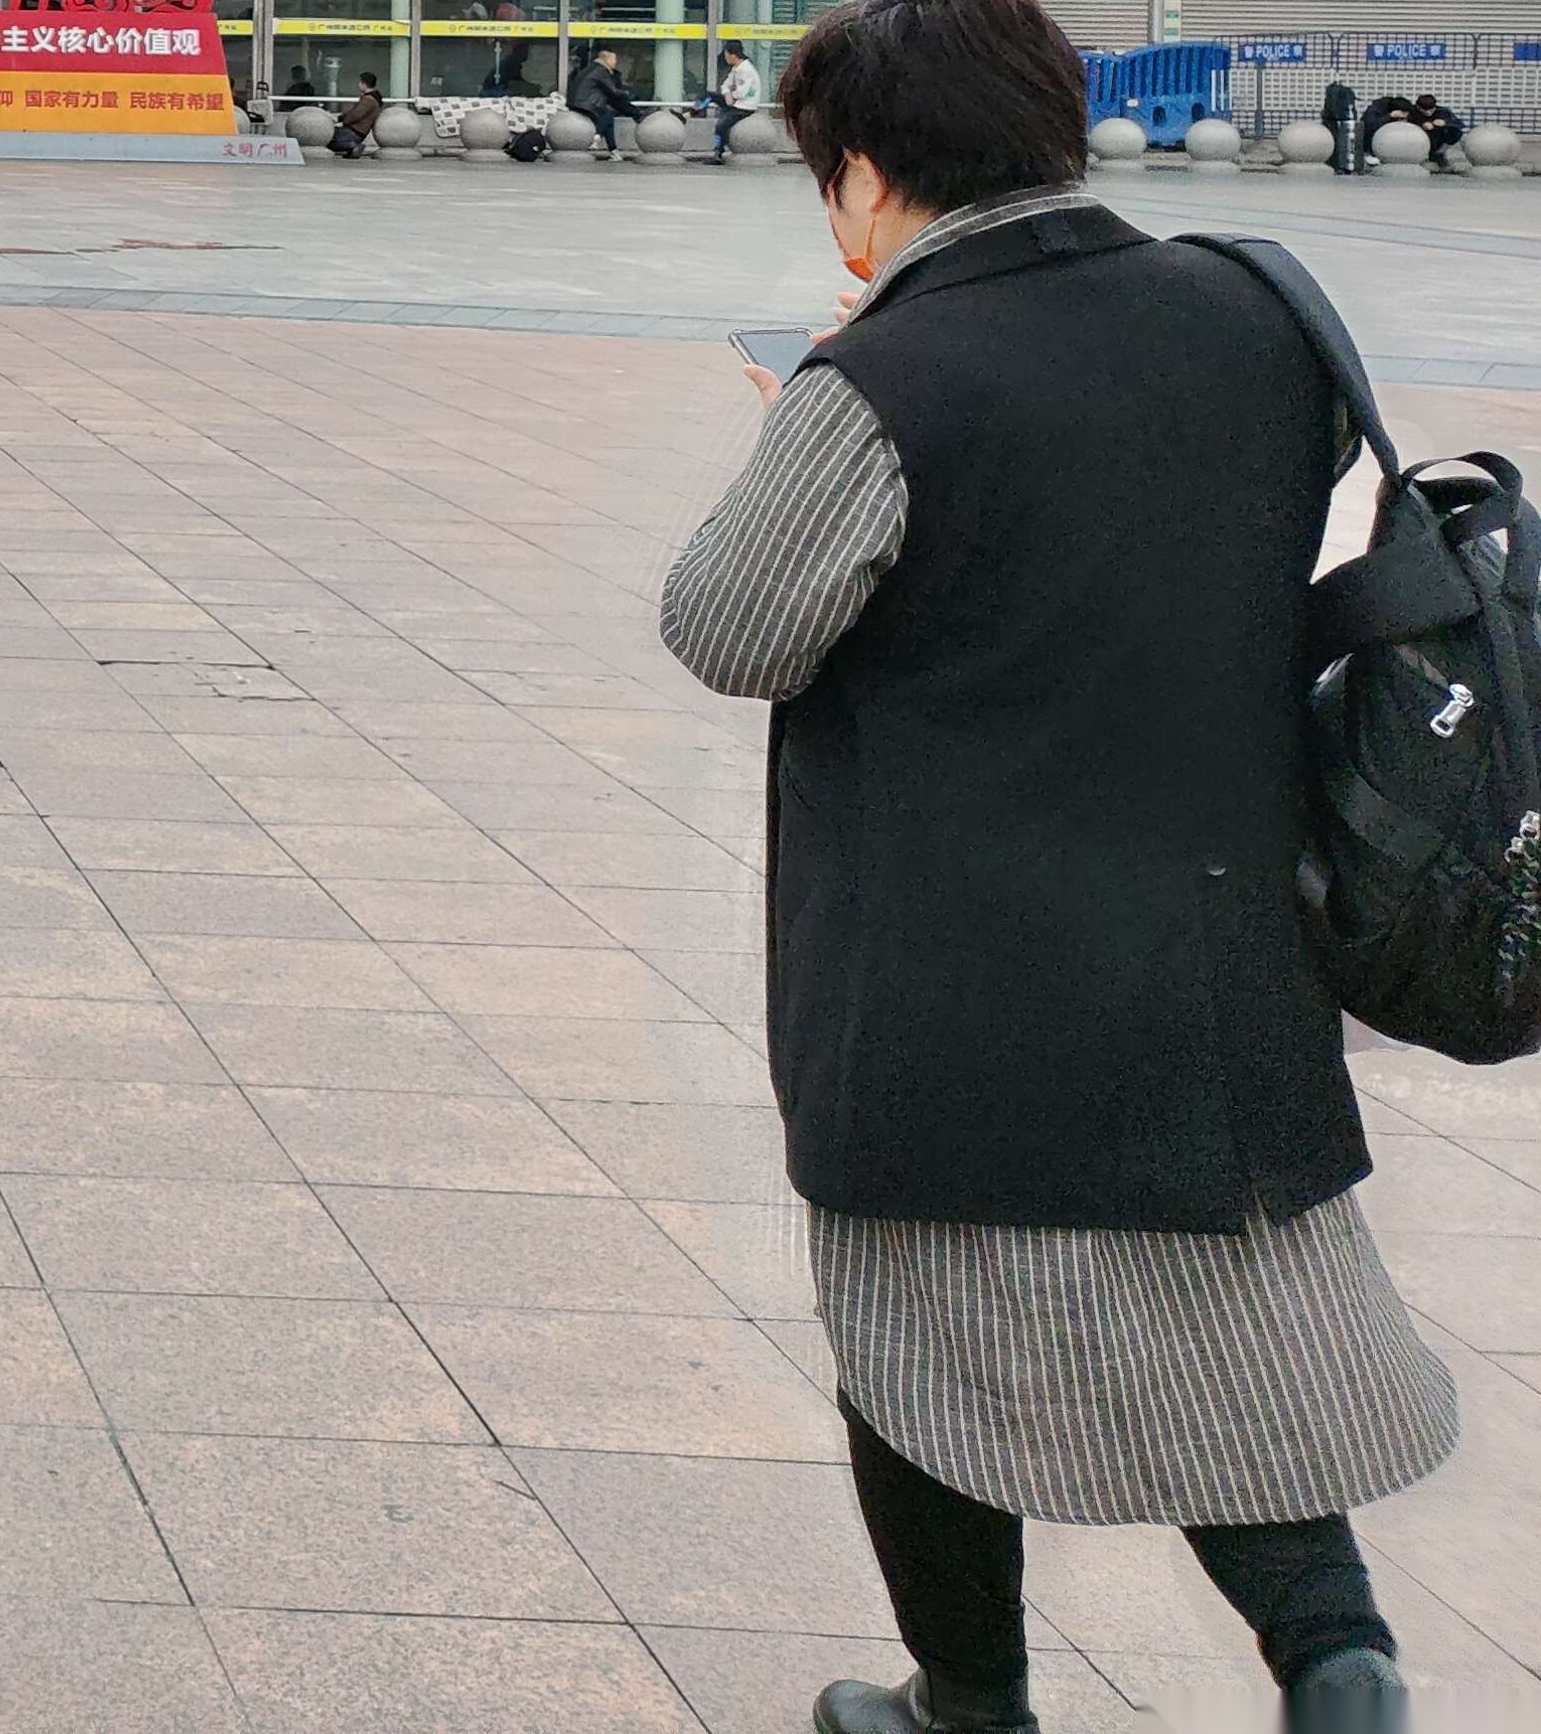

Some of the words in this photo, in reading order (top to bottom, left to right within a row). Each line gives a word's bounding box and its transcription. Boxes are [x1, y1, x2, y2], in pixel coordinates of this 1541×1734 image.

[1255, 43, 1290, 59] POLICE
[1386, 42, 1427, 59] POLICE
[24, 90, 119, 110] 国家有力量
[129, 92, 225, 112] 民族有希望
[222, 141, 288, 159] 文明广州
